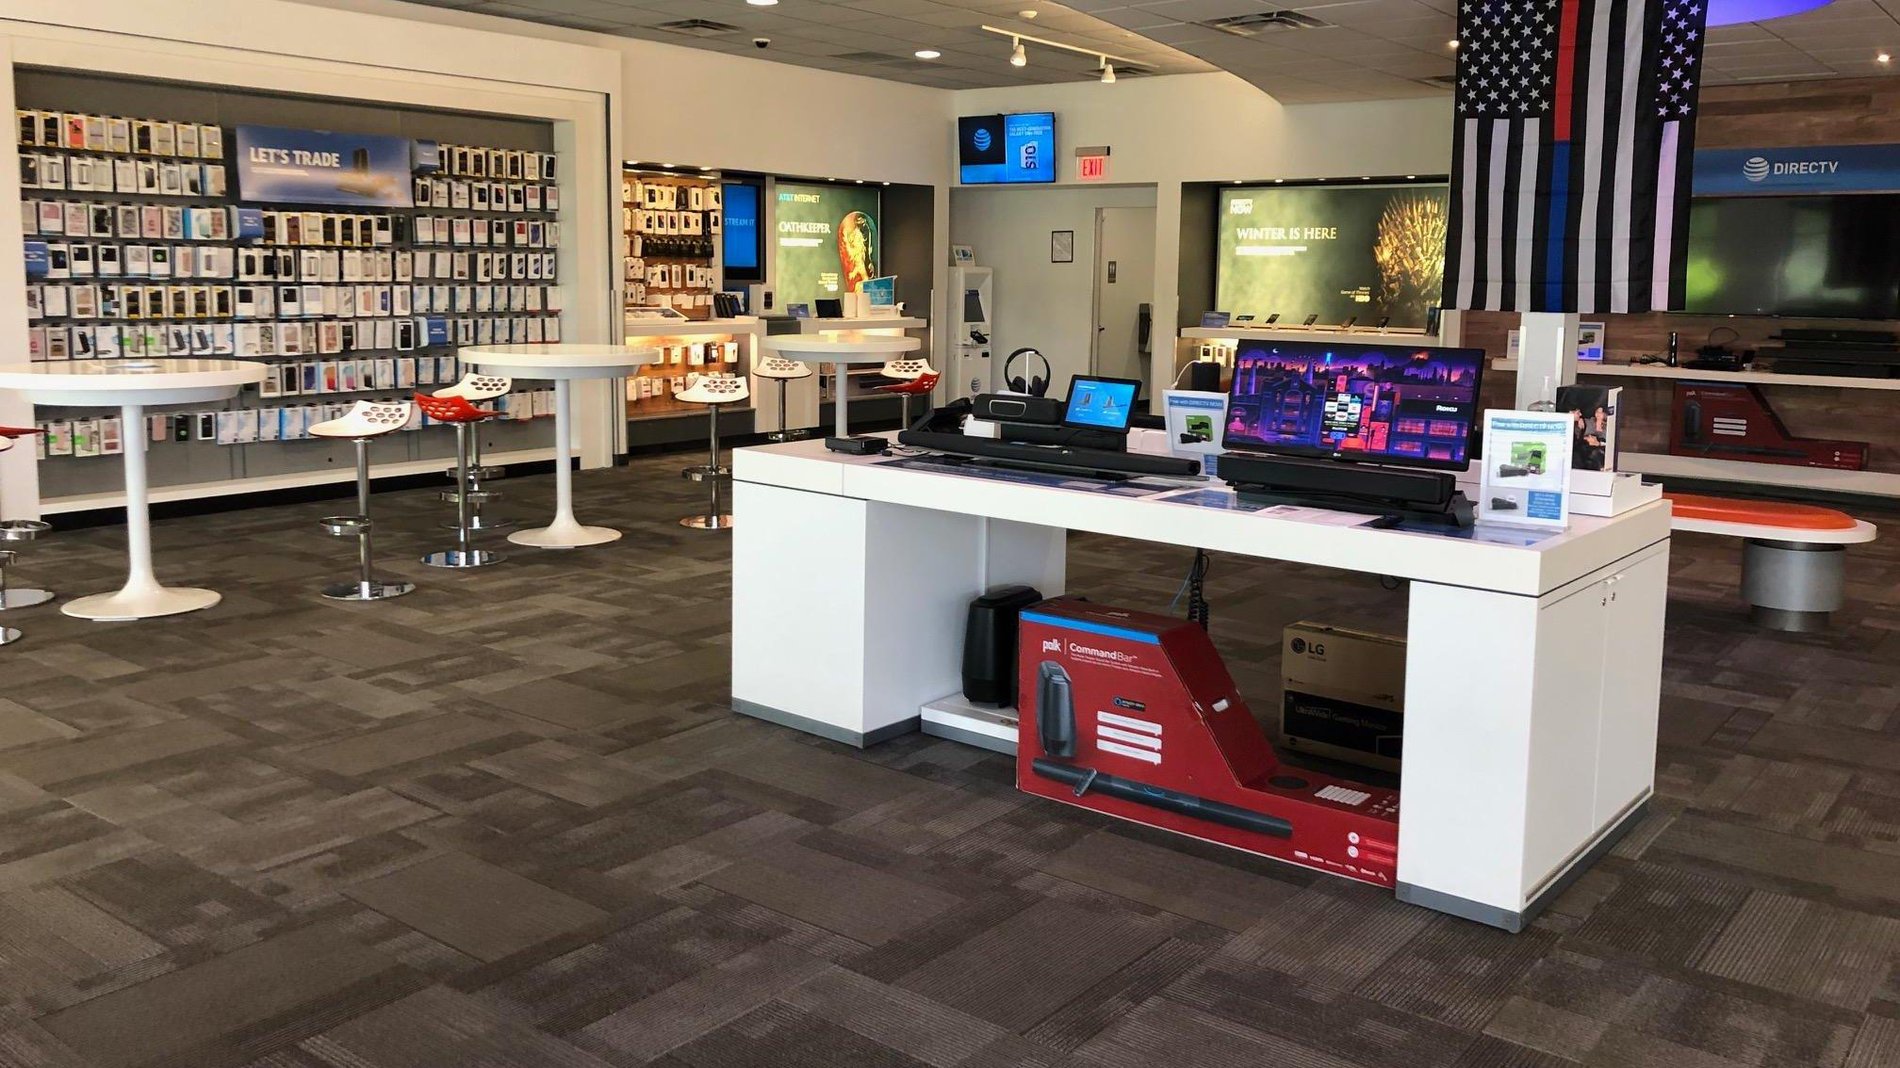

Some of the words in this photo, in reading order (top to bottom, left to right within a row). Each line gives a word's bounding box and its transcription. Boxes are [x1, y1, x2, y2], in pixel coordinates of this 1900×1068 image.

[250, 147, 289, 165] LET'S
[290, 150, 341, 168] TRADE
[1025, 146, 1037, 169] S10
[1083, 158, 1103, 176] EXIT
[1773, 162, 1838, 175] DIRECTV
[794, 194, 820, 204] INTERNET
[724, 217, 748, 227] STREAM
[779, 221, 831, 234] OATHKEEPER
[1236, 227, 1287, 240] WINTER
[1289, 227, 1300, 240] IS
[1304, 227, 1337, 240] HERE
[1308, 642, 1325, 655] LG
